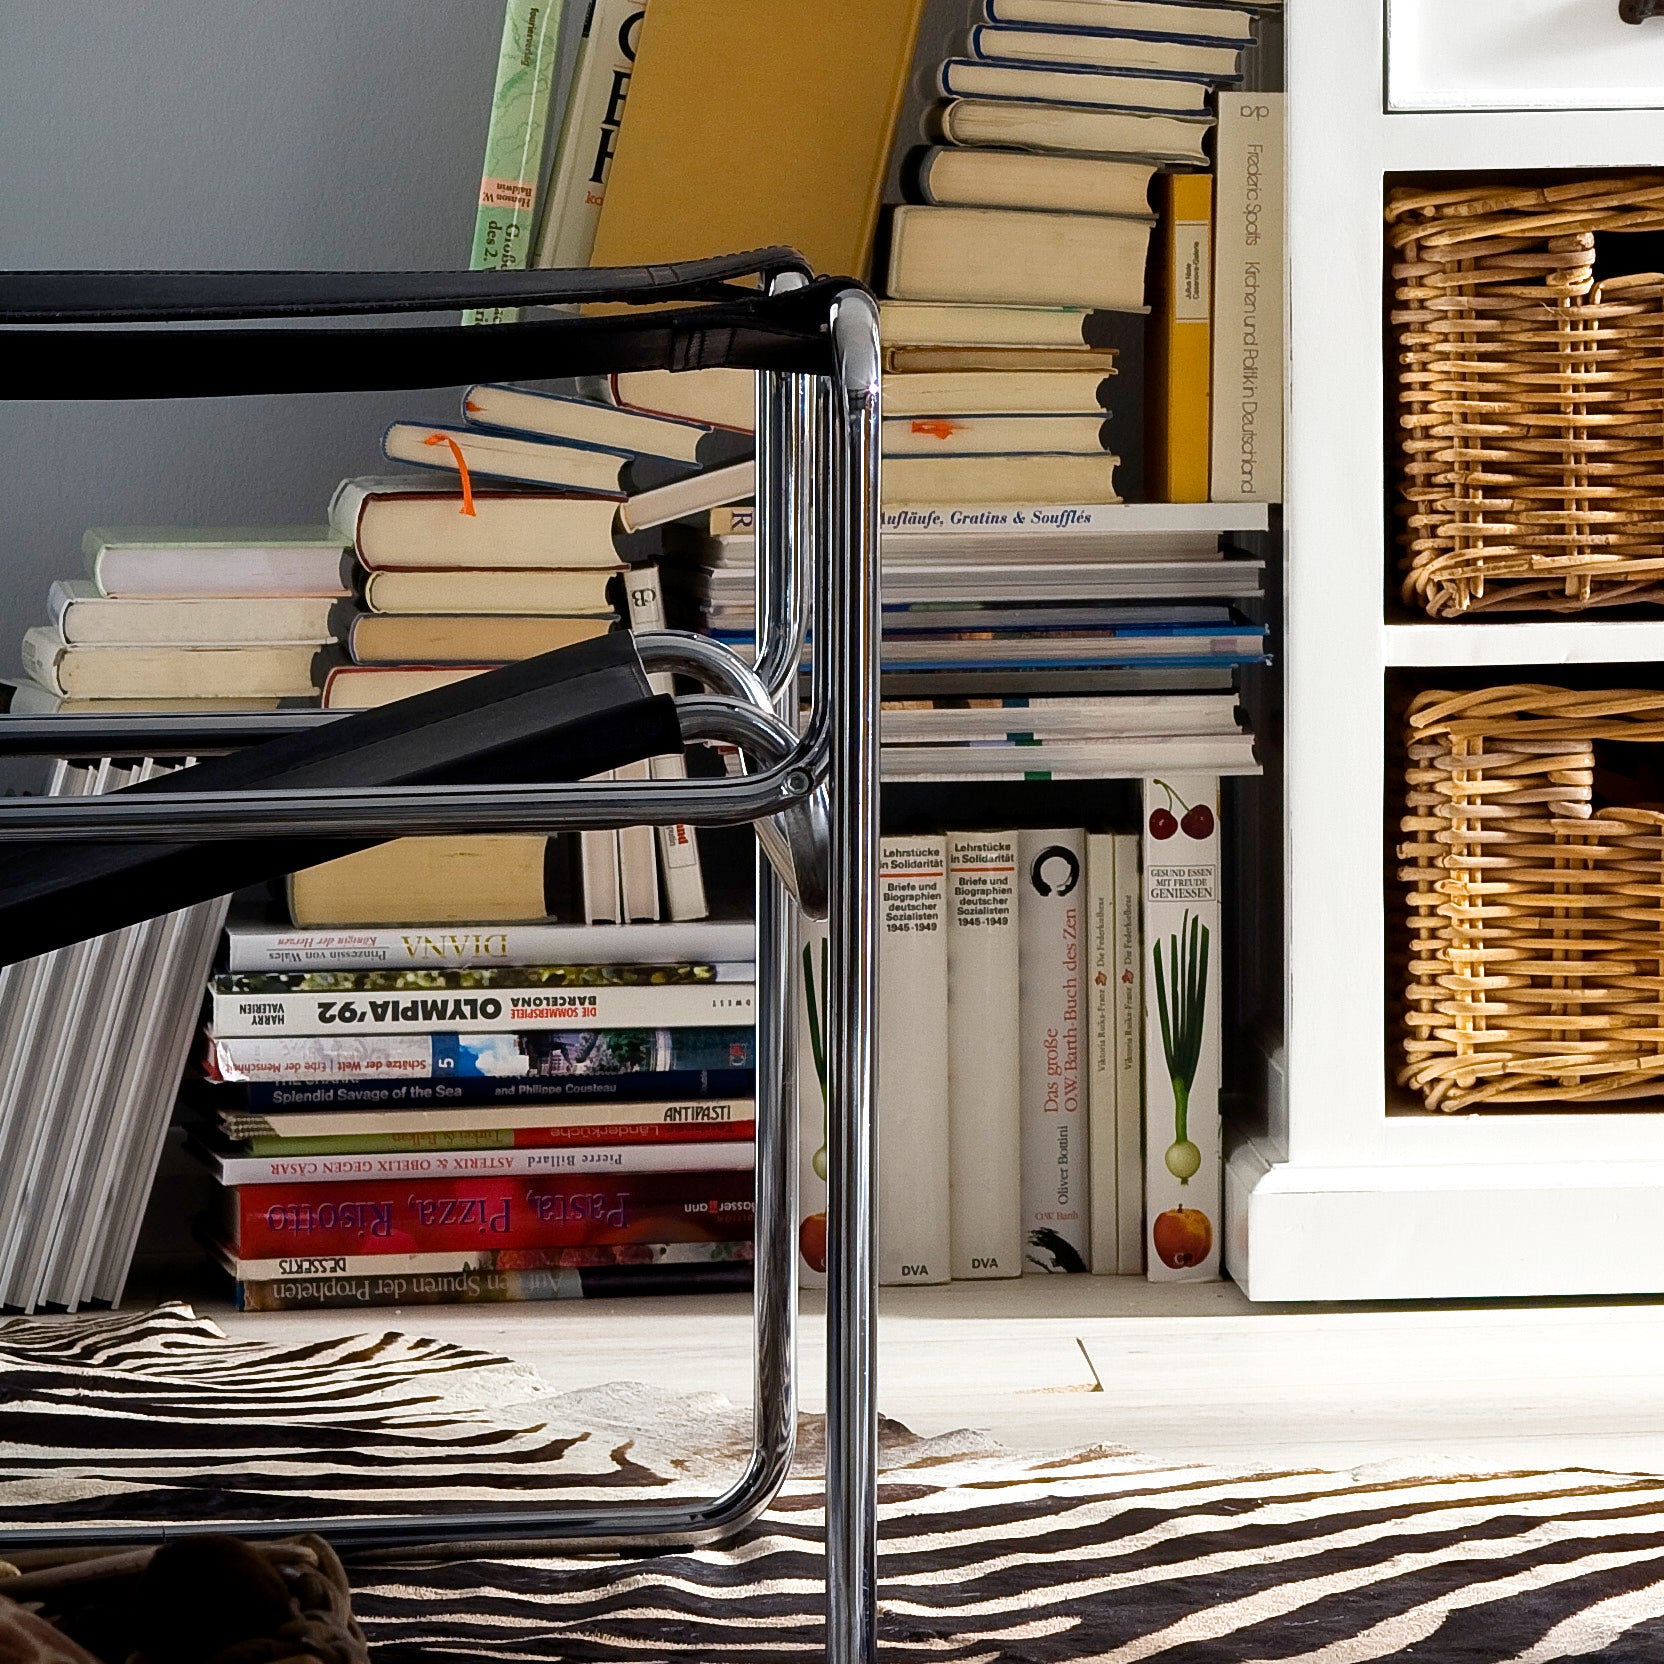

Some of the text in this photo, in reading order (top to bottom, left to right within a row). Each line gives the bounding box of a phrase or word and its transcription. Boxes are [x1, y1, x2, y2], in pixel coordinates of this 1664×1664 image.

[950, 511, 1007, 524] Gratins
[1013, 512, 1025, 523] &
[1031, 510, 1091, 528] Soufflés
[954, 843, 1011, 852] Lehrstücke
[951, 853, 1014, 863] in Solidarität
[1151, 869, 1212, 877] GESUND ESSEN
[990, 877, 1008, 885] und
[1156, 878, 1207, 886] MIT FREUDE
[955, 887, 1012, 896] Biographien
[1151, 888, 1212, 898] GENIESSEN
[959, 897, 1008, 905] deutscher
[957, 907, 1009, 915] Sozialisten
[1063, 908, 1077, 939] Zen
[403, 934, 508, 958] DIANA
[1063, 940, 1077, 971] des
[511, 996, 596, 1006] BARCELONA
[240, 1003, 284, 1014] VALERIEN
[251, 1014, 284, 1025] HARRY
[1044, 1029, 1061, 1112] Das große
[273, 1085, 462, 1104] Splendid Savage of the Sea
[664, 1105, 730, 1121] ANTIPASTI
[323, 1161, 372, 1171] GEGEN
[378, 1159, 430, 1170] OBELIX
[437, 1159, 449, 1169] &
[453, 1156, 514, 1170] ASTERIX
[267, 1201, 393, 1237] Risotto
[279, 1258, 346, 1274] DESSERTS
